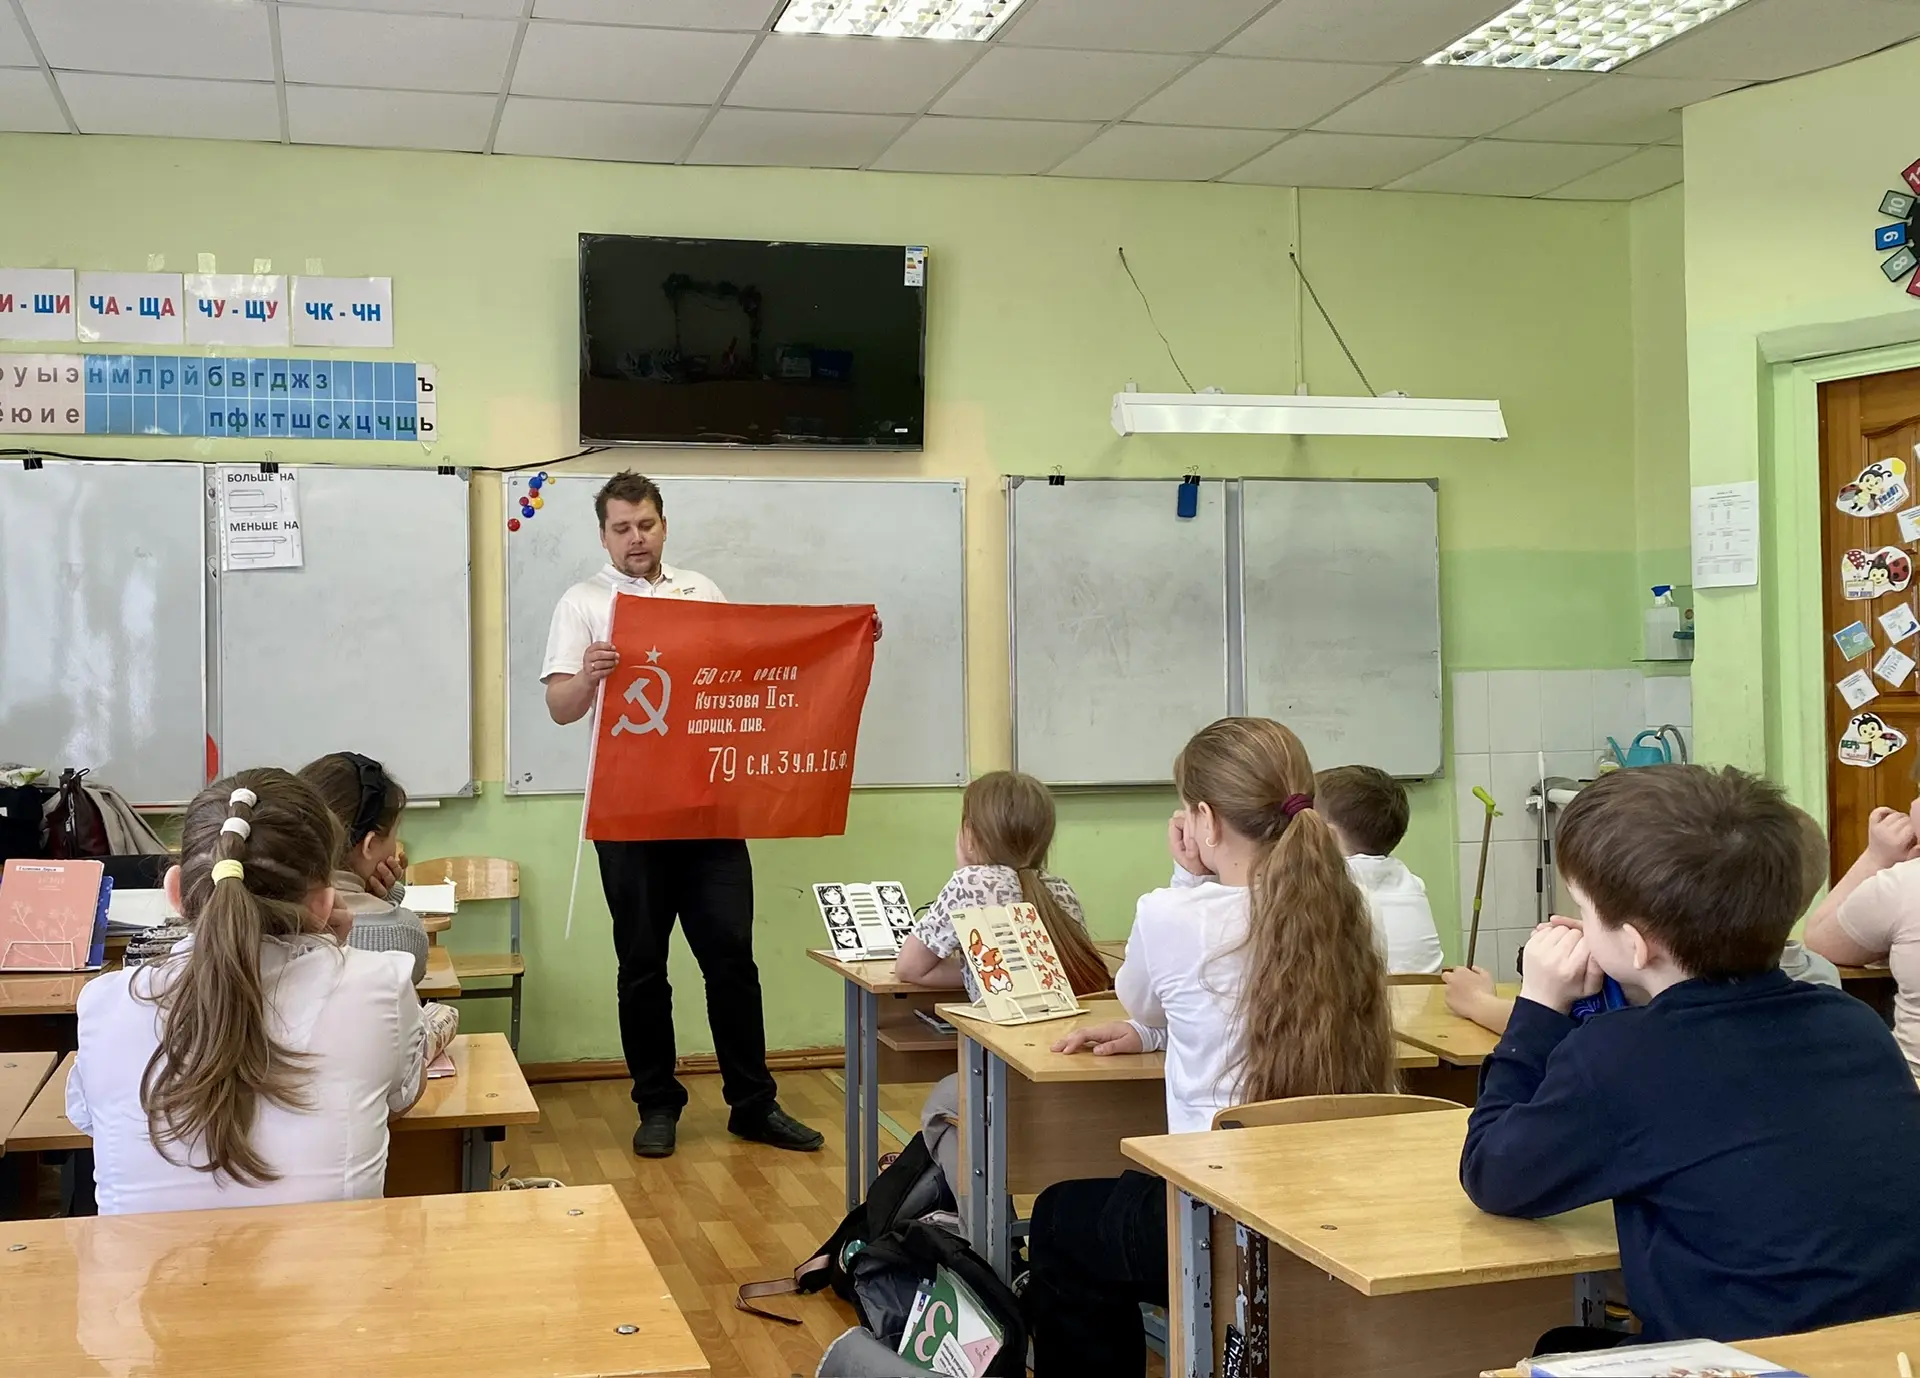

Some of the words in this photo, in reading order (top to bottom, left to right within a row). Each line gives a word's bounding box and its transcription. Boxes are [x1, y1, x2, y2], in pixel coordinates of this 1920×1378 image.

[1888, 197, 1906, 215] 10
[1893, 256, 1908, 271] 8
[34, 294, 70, 314] ШИ
[89, 295, 120, 316] ЧА
[139, 297, 175, 320] ЩА
[198, 299, 225, 318] ЧУ
[245, 300, 278, 322] ЩУ
[305, 302, 334, 321] ЧК
[352, 303, 381, 322] ЧН
[14, 366, 28, 387] у
[38, 367, 57, 383] ы
[66, 367, 79, 383] э
[89, 368, 102, 384] н
[112, 368, 129, 384] м
[136, 368, 152, 384] л
[160, 369, 175, 389] р
[184, 365, 198, 386] й
[208, 365, 223, 387] б
[231, 372, 246, 387] в
[254, 372, 265, 387] г
[270, 373, 287, 391] д
[291, 373, 310, 388] ж
[315, 373, 328, 389] з
[11, 407, 32, 423] ю
[41, 407, 55, 423] и
[65, 407, 80, 423] е
[210, 412, 223, 427] п
[227, 407, 248, 432] ф
[254, 413, 266, 428] к
[272, 413, 285, 428] т
[292, 414, 311, 428] ш
[316, 414, 330, 429] с
[336, 414, 350, 429] х
[356, 415, 371, 433] ц
[377, 415, 390, 430] ч
[397, 416, 416, 434] щ
[227, 473, 274, 482] БОЛЬШЕ
[280, 473, 295, 481] НА
[230, 521, 278, 531] МЕНЬШЕ
[284, 521, 299, 530] НА
[692, 668, 718, 685] 150
[709, 746, 737, 783] 79
